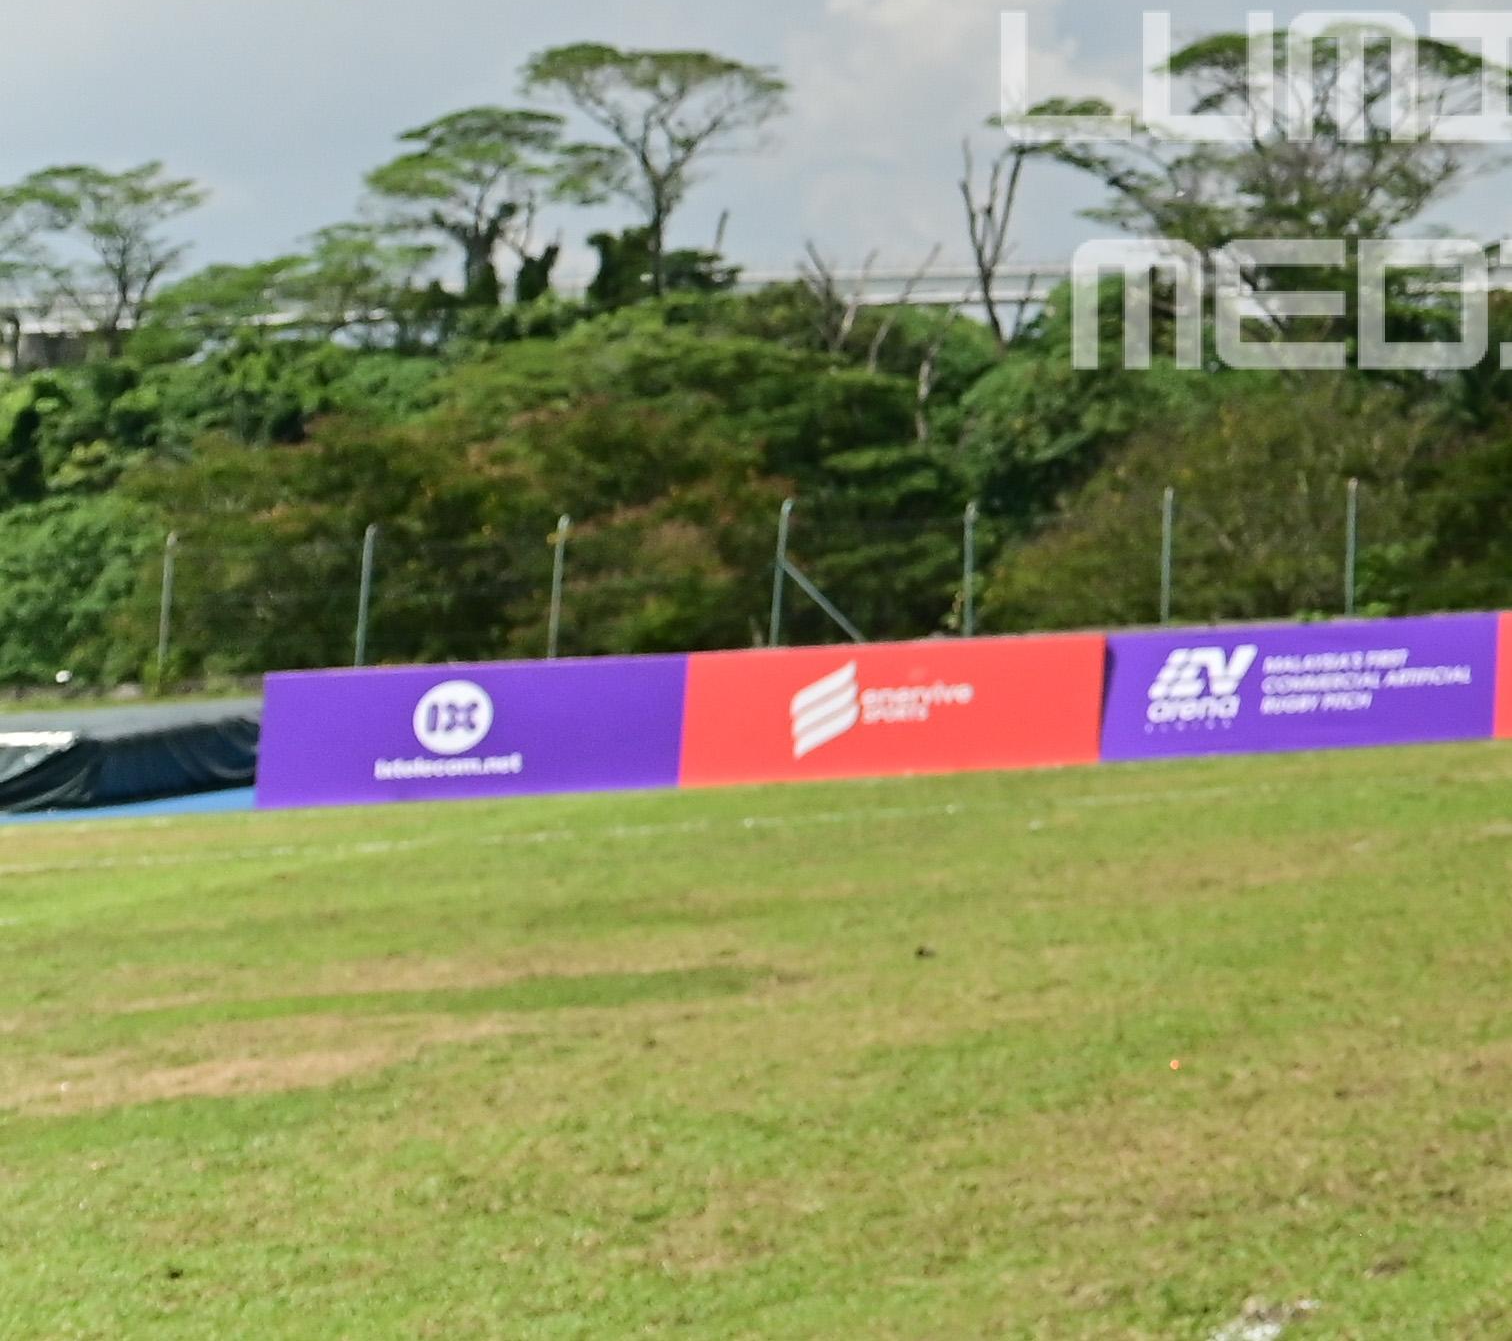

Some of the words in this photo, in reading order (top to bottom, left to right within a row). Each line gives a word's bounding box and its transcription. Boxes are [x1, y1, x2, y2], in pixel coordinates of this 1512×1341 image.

[1260, 670, 1381, 696] COMMERCIAL
[1383, 665, 1472, 688] ARTIFICIAL
[1146, 695, 1241, 724] arena
